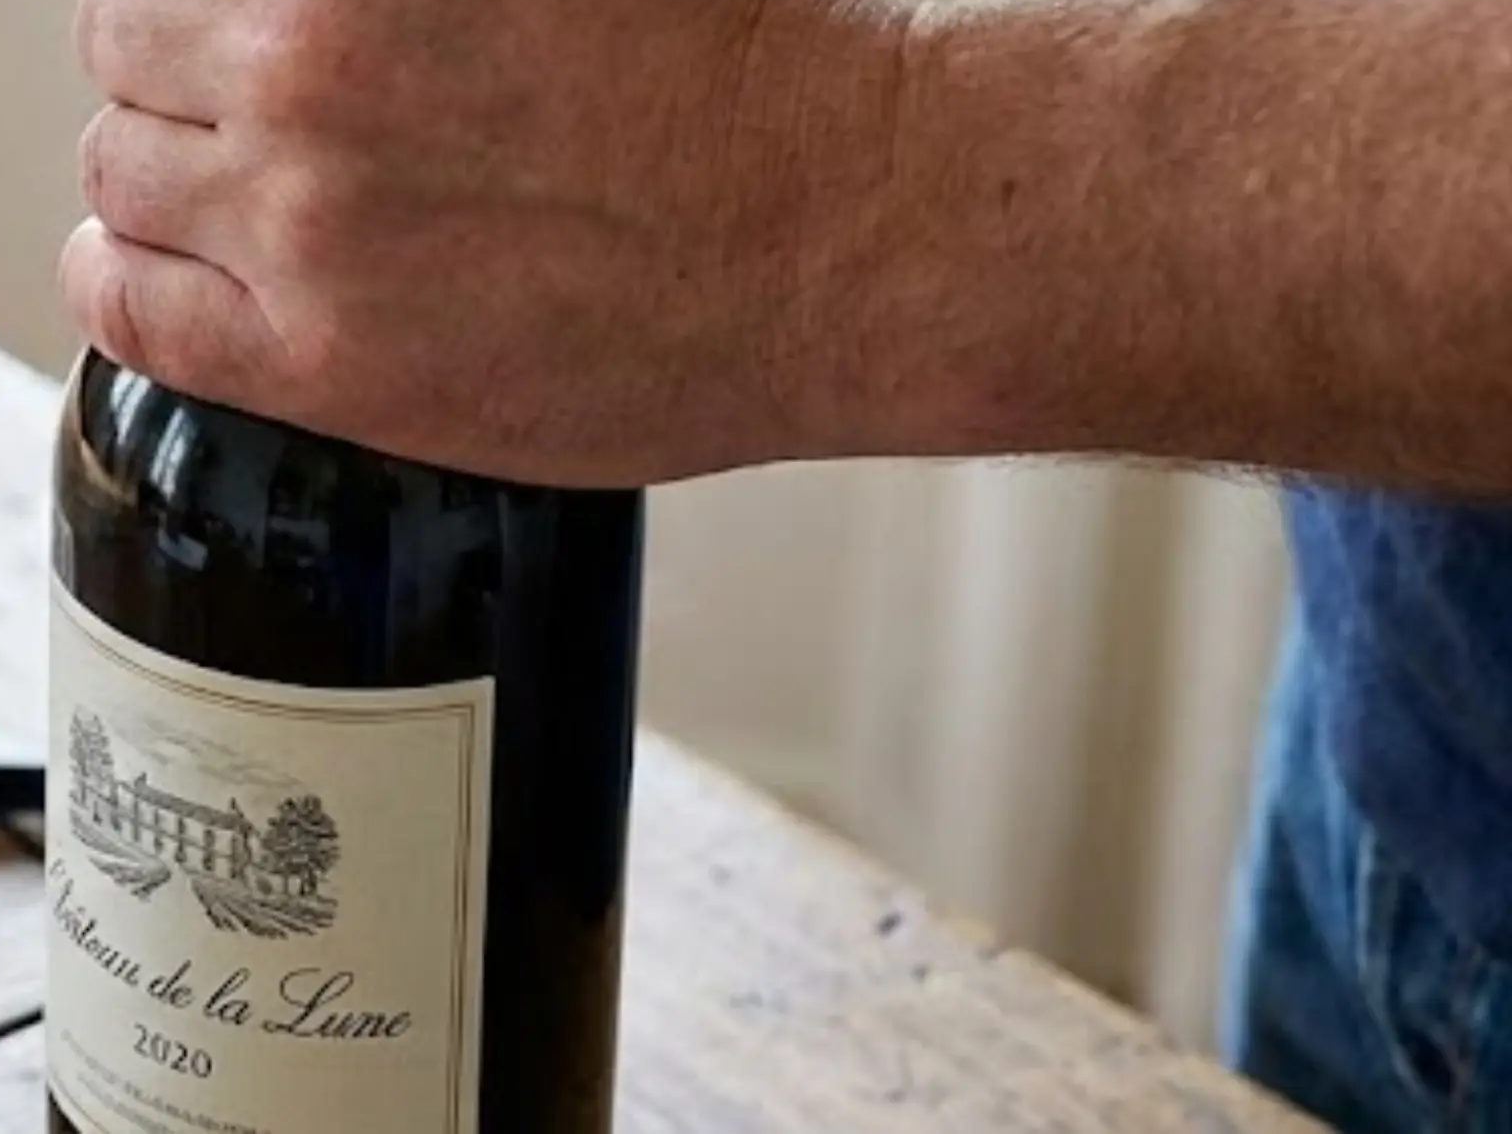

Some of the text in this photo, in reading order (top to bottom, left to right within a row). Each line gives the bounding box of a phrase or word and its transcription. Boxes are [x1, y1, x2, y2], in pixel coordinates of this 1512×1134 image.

[146, 958, 193, 1009] de
[203, 967, 253, 1027] la
[261, 967, 413, 1039] Lune
[133, 1022, 214, 1079] 2020
